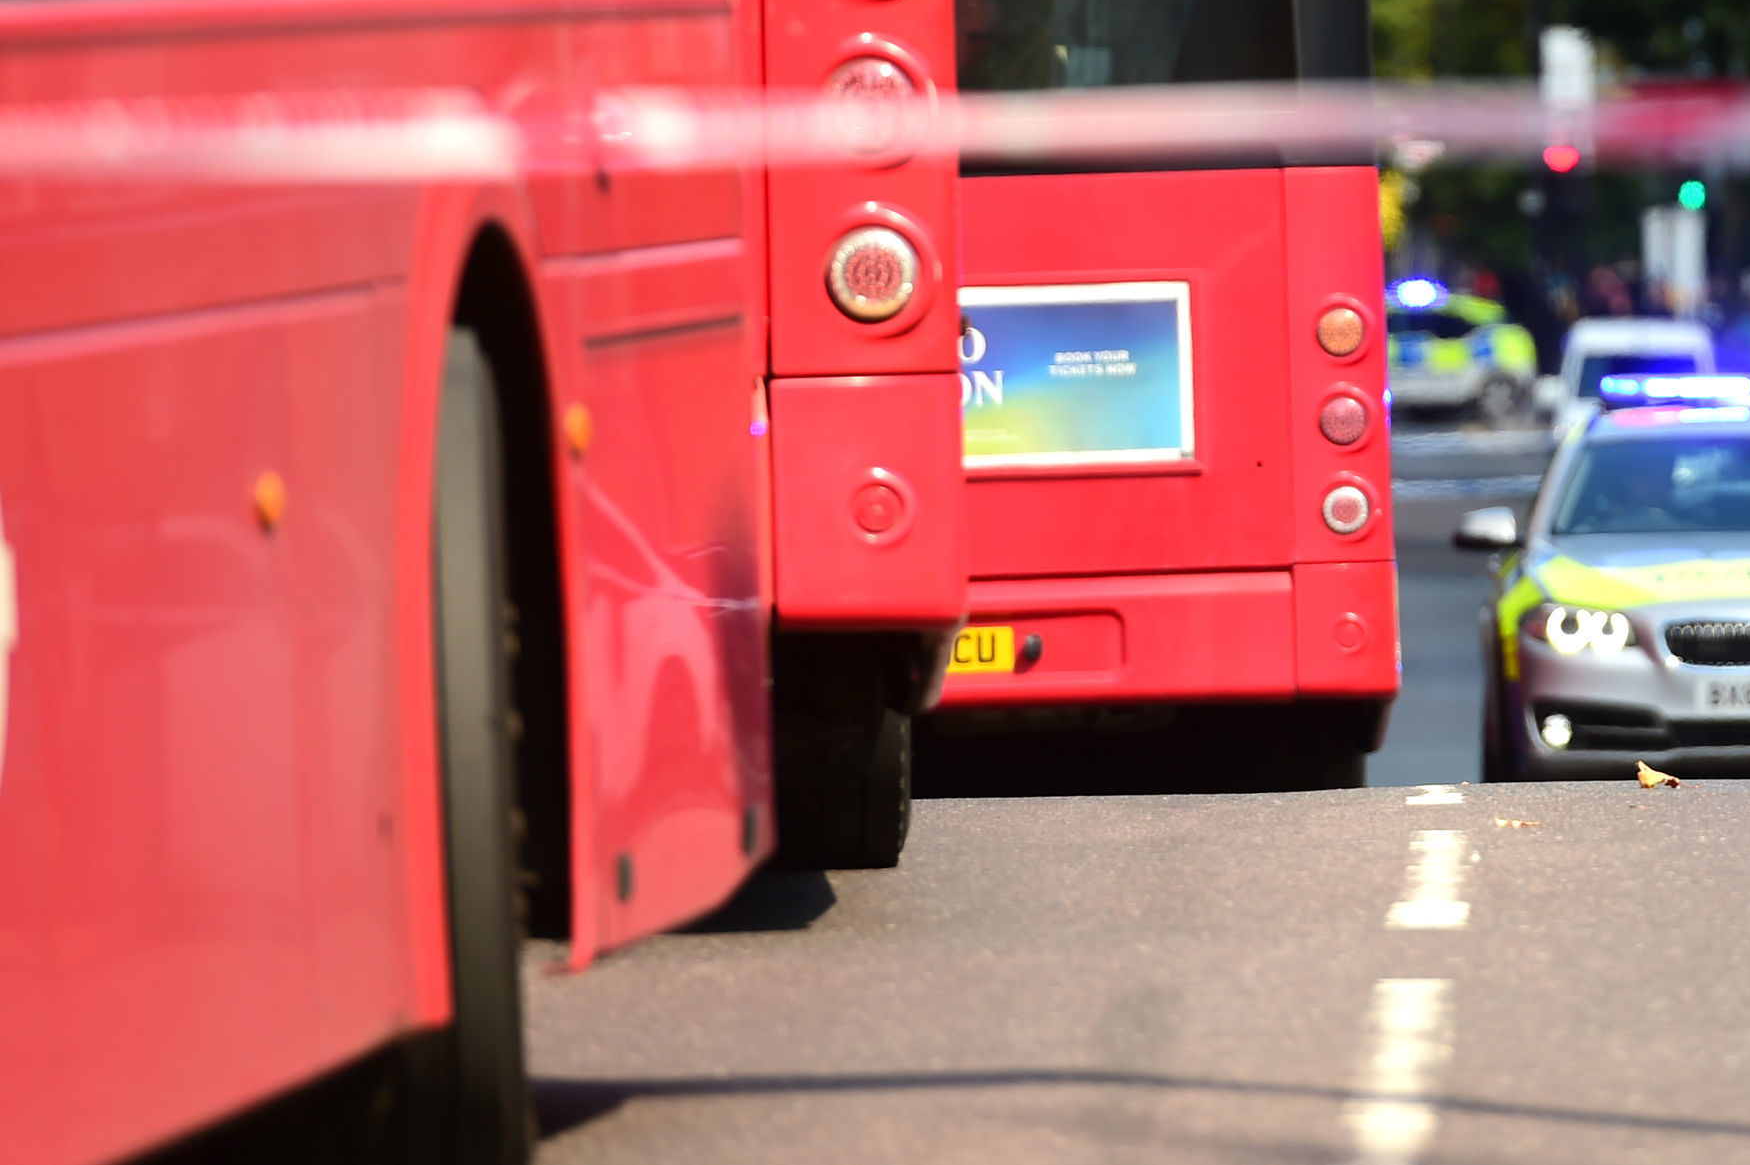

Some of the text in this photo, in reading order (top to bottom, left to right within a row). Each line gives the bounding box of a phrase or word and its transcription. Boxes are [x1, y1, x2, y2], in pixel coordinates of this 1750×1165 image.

[1054, 349, 1130, 363] BOOK YOUR
[1047, 363, 1104, 375] TICKETS
